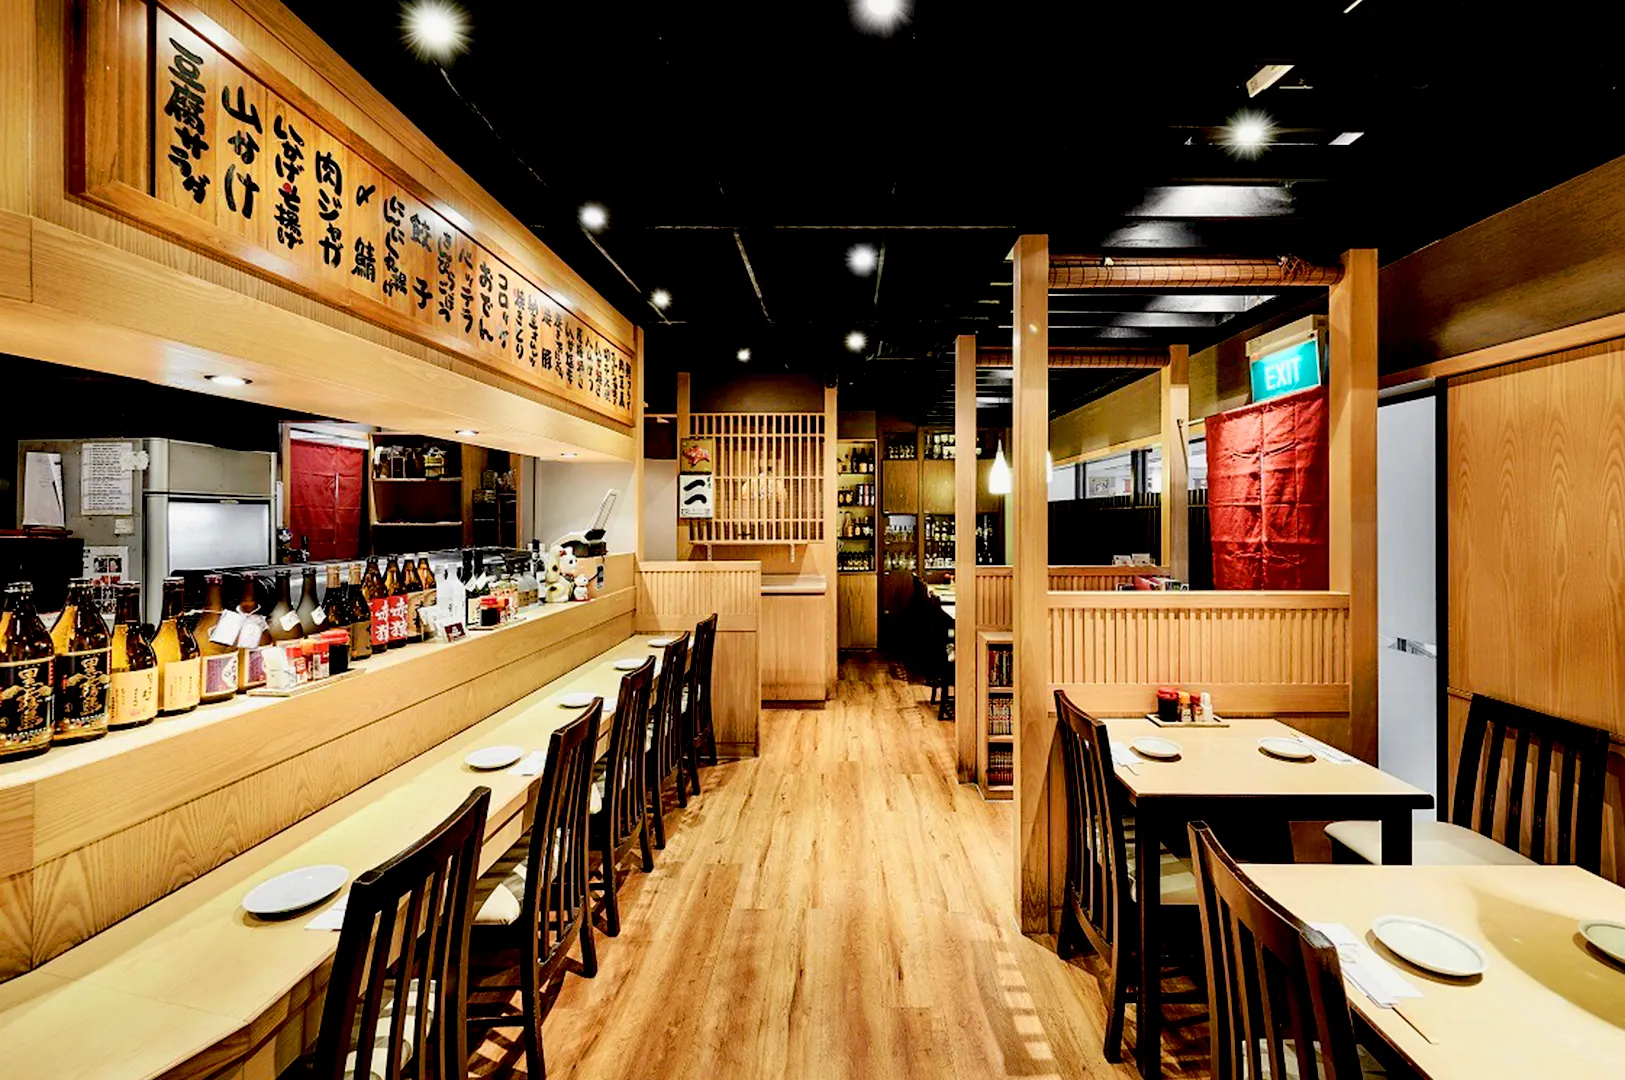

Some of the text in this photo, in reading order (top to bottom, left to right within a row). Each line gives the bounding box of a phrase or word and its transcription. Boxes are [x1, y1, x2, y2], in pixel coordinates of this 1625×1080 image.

[164, 37, 211, 204] 豆腐サラダ
[221, 85, 263, 219] 山かけ
[315, 150, 343, 268] 肉ジャガ
[351, 184, 376, 283] 〆鯖
[410, 213, 433, 310] 餃子
[479, 260, 494, 342] おでん
[498, 273, 509, 349] コロッケ
[1264, 356, 1302, 391] EXIT
